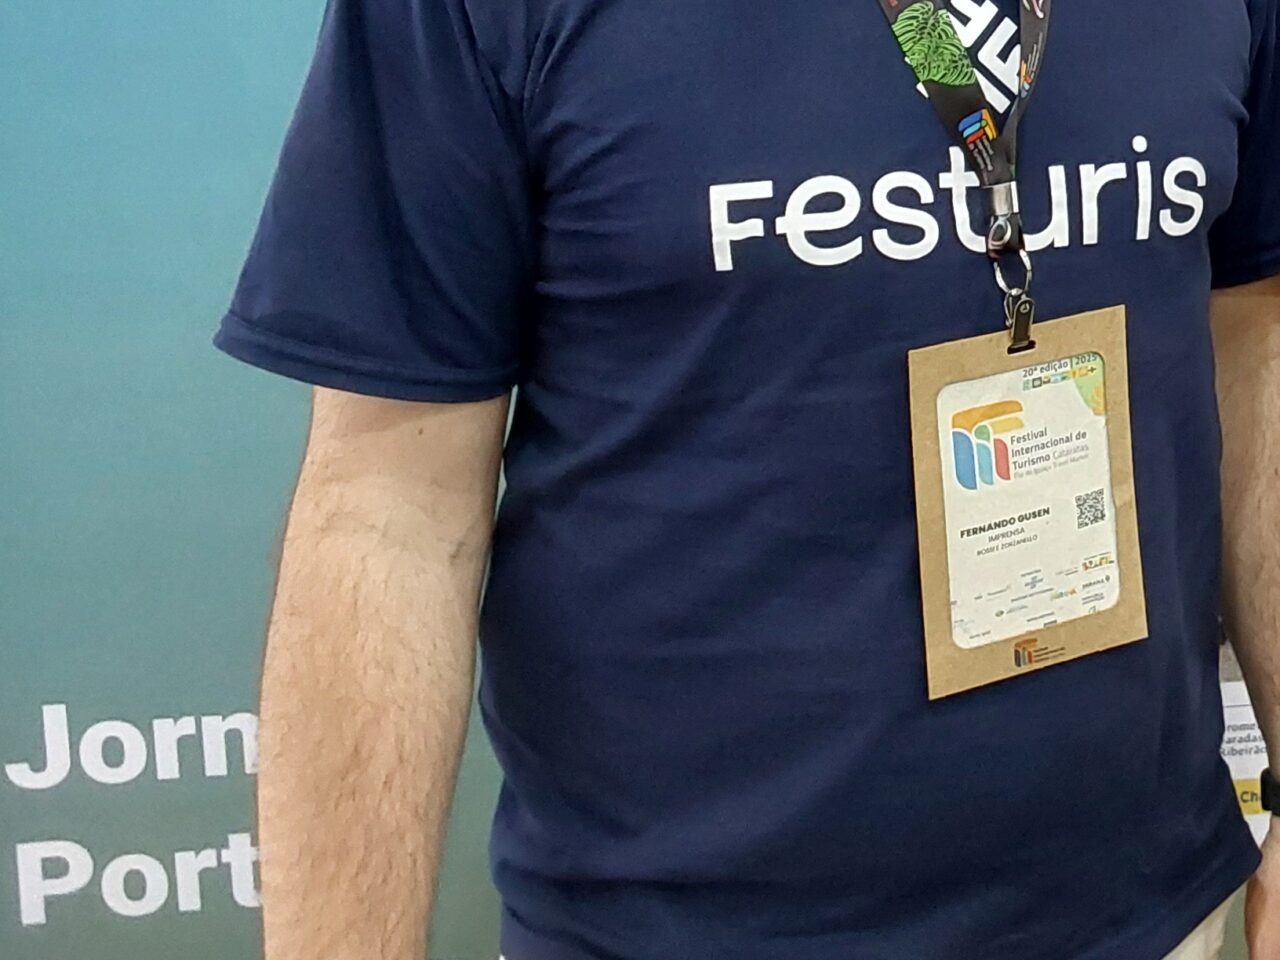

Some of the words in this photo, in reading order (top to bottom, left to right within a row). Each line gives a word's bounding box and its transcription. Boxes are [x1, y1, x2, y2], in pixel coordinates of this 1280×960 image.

[709, 135, 1207, 271] Festuris
[1040, 360, 1069, 374] edição
[1010, 427, 1048, 445] Festival
[1011, 432, 1073, 458] Internacional
[1075, 431, 1087, 441] de
[1012, 454, 1051, 470] Turismo
[960, 516, 1016, 539] FERNANDO
[1017, 507, 1050, 523] GUSEN
[4, 704, 260, 790] Jorn
[15, 833, 261, 928] Port
